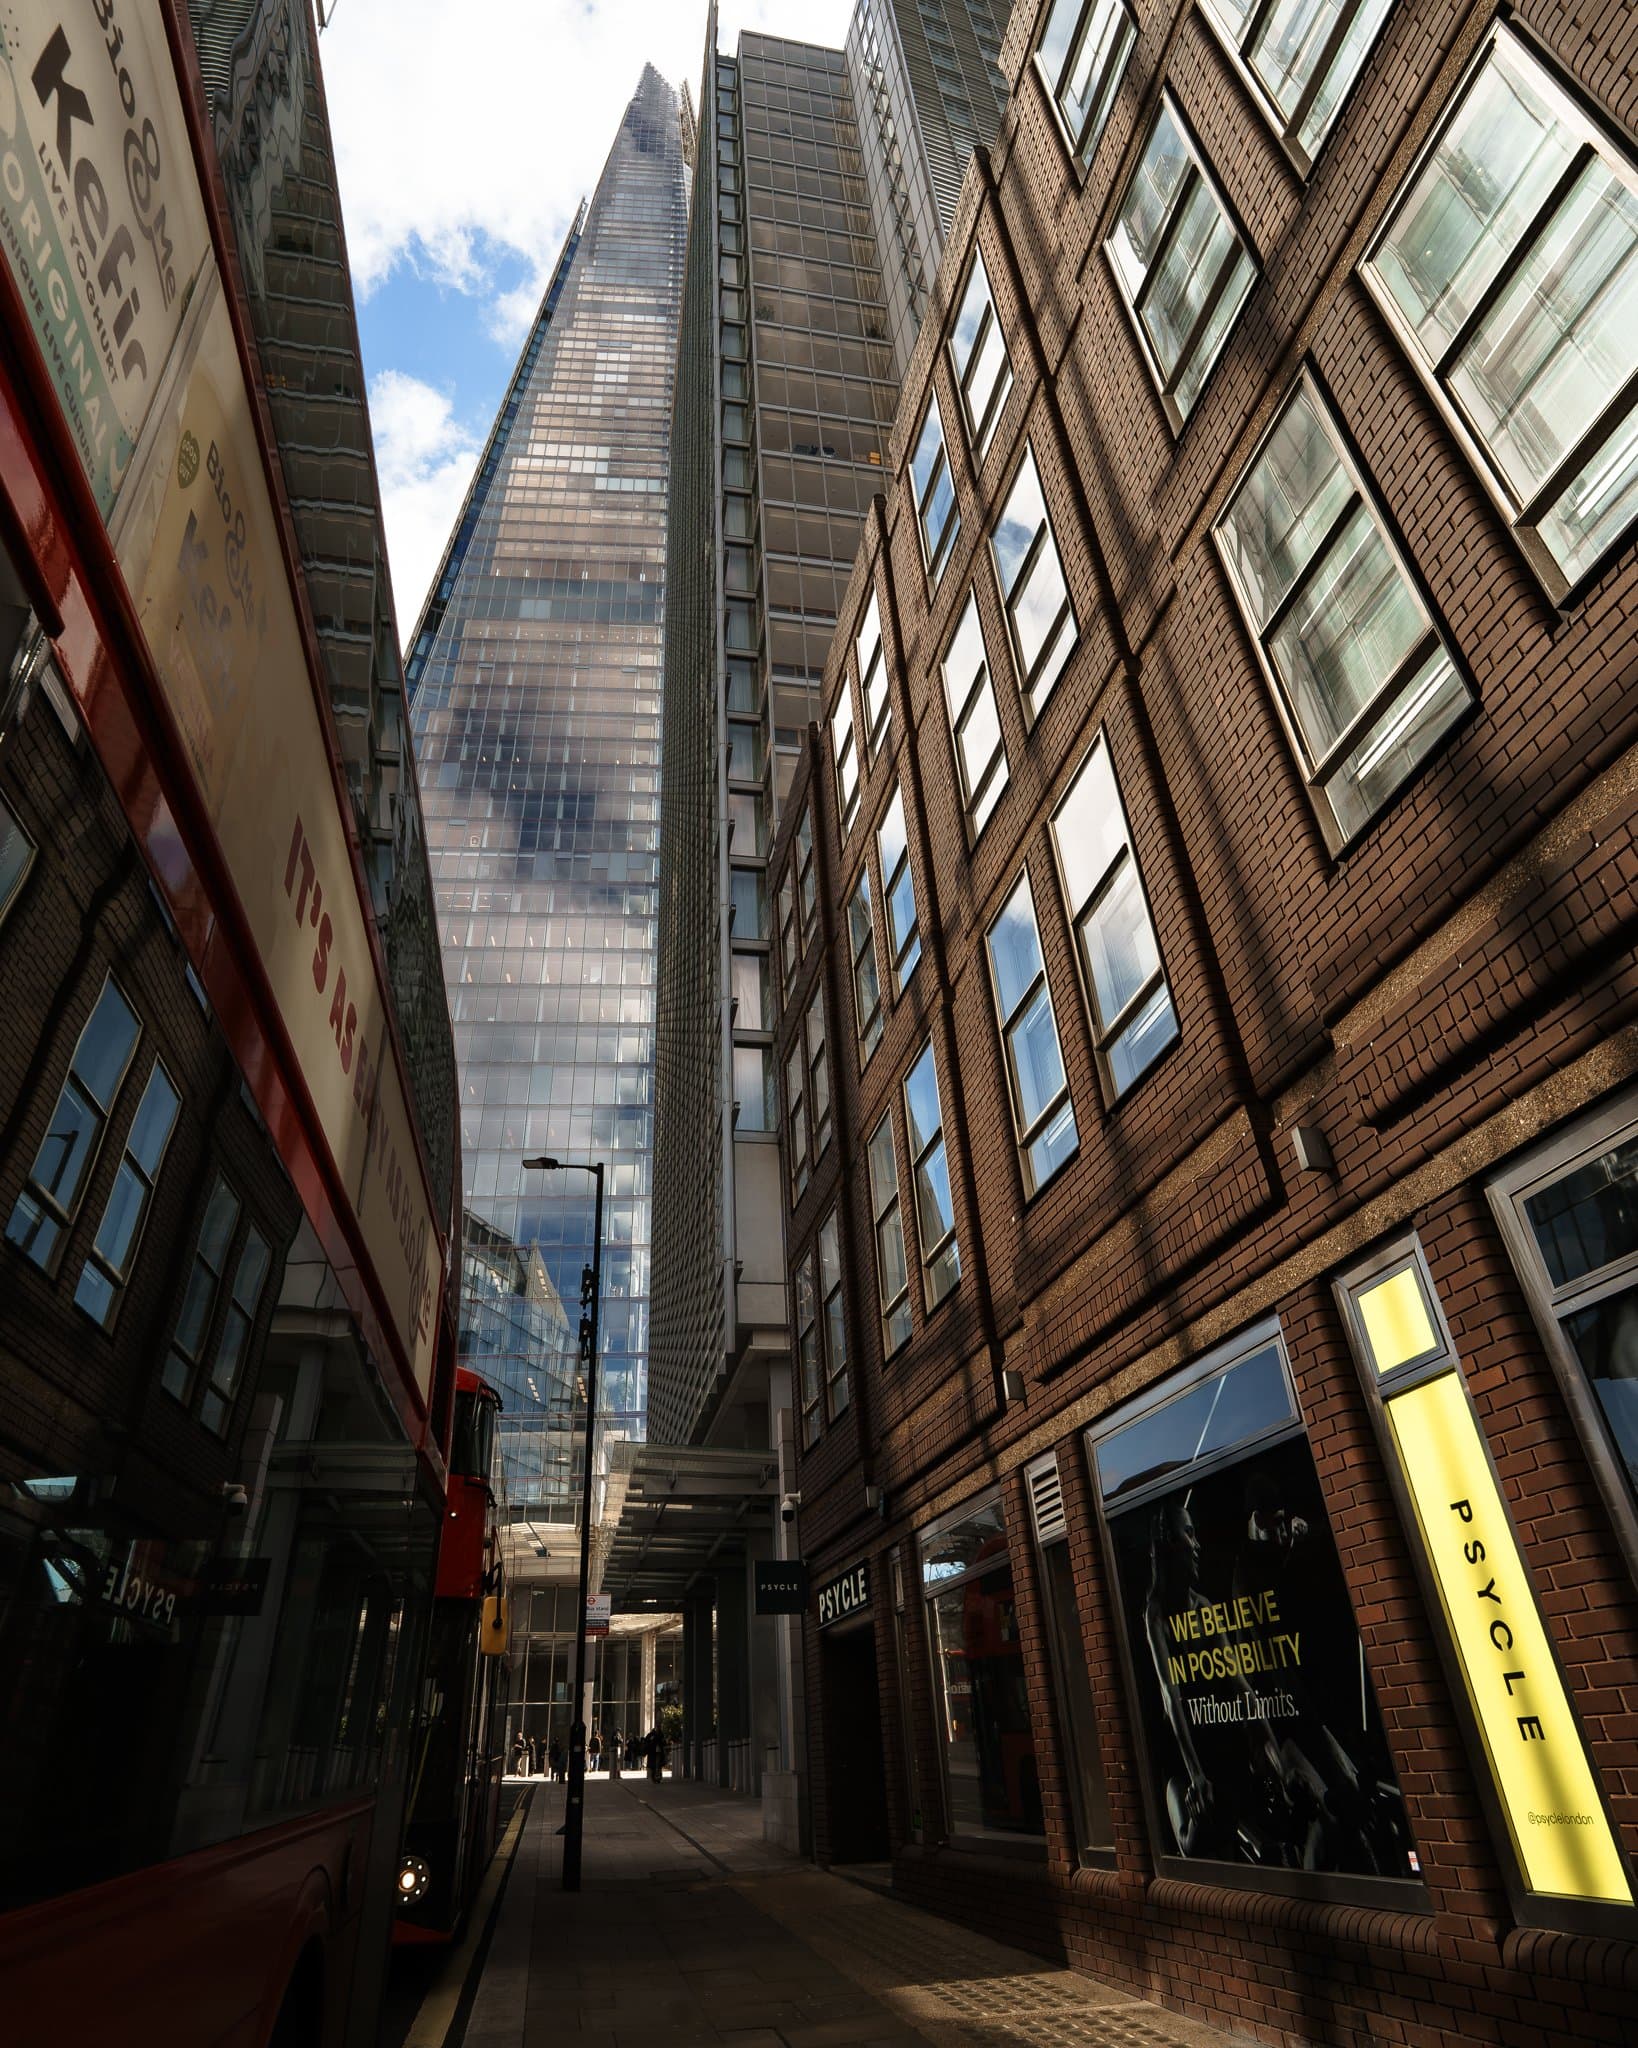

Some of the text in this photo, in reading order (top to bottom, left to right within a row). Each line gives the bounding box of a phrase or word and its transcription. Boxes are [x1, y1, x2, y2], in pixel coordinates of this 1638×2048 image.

[31, 23, 147, 381] Kefir
[38, 141, 119, 384] LIVE YOGHURT
[0, 207, 96, 481] UNIQUE LIVE CULTURES
[3, 151, 107, 457] ORIGINAL
[284, 812, 333, 994] IT'S
[329, 964, 358, 1075] AS
[760, 1583, 799, 1592] PSYCLE
[818, 1567, 867, 1624] PSYCLE
[1167, 1632, 1302, 1686] IN POSSIBILITY
[1169, 1589, 1281, 1643] WE BELIEVE
[1449, 1498, 1546, 1742] PSYCLE
[1188, 1687, 1300, 1726] Without Limits.
[1527, 1810, 1594, 1827] @psyclelondon
